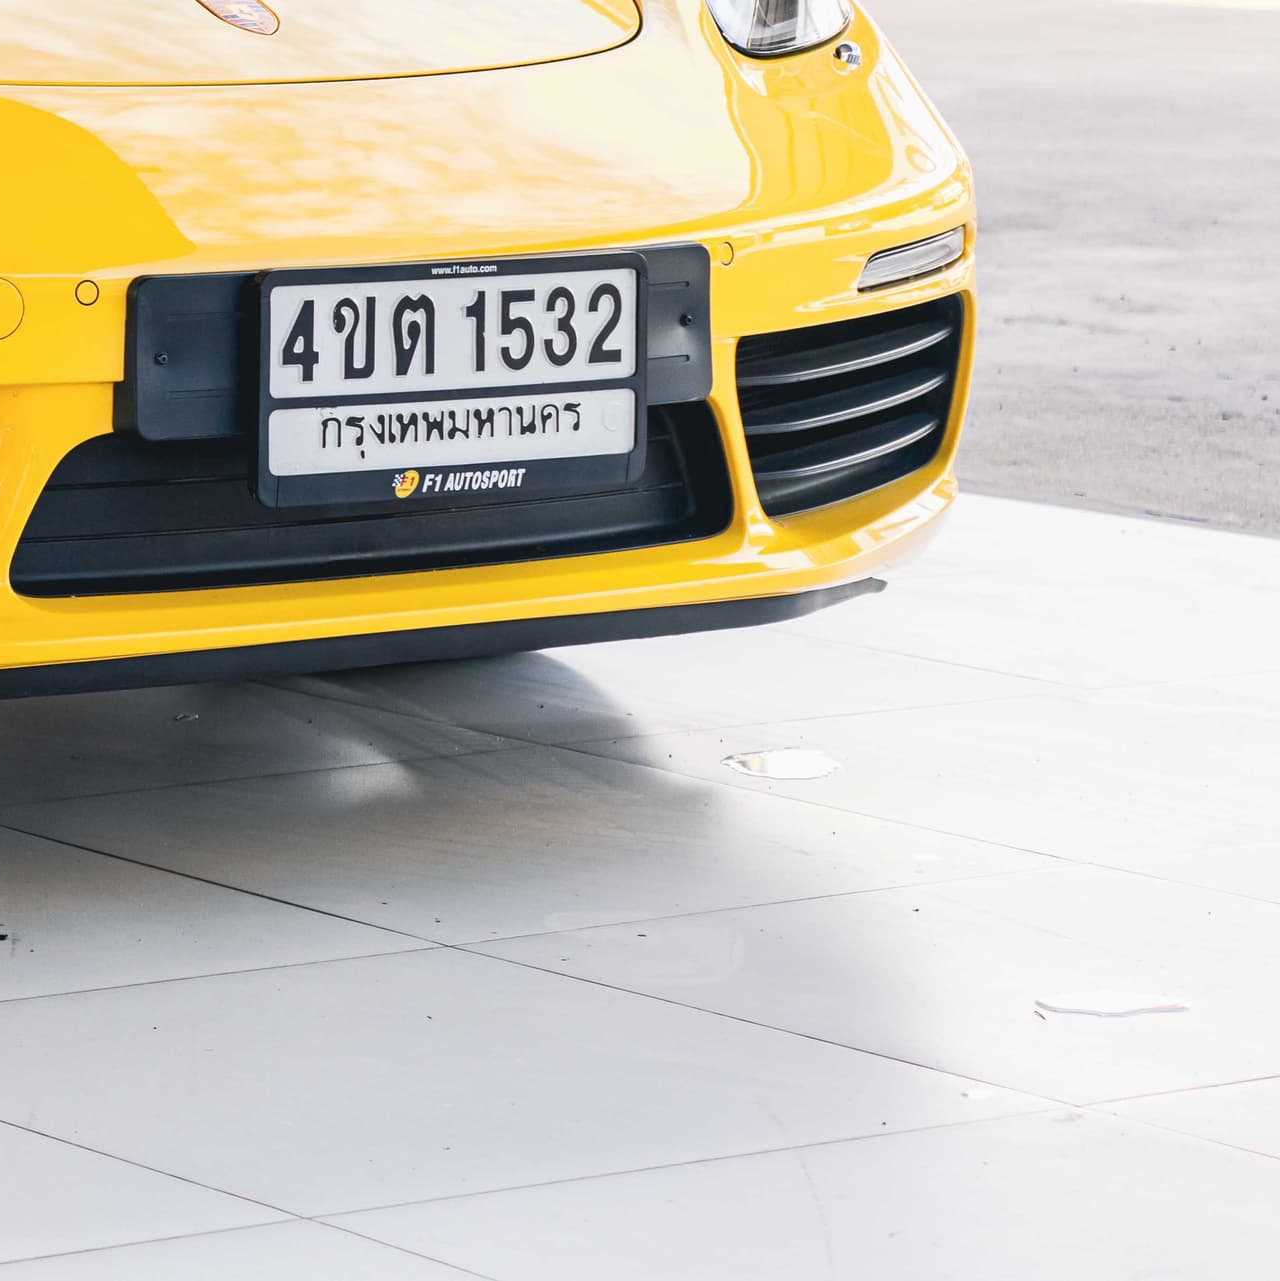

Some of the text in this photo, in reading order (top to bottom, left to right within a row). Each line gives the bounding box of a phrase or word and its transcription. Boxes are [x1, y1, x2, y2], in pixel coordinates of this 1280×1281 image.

[431, 264, 498, 276] www.f1auto.com
[281, 283, 623, 382] 4ขต 1532
[321, 401, 582, 459] กรุงเทพมหานคร
[422, 468, 526, 493] F1 AUTOSPORT
